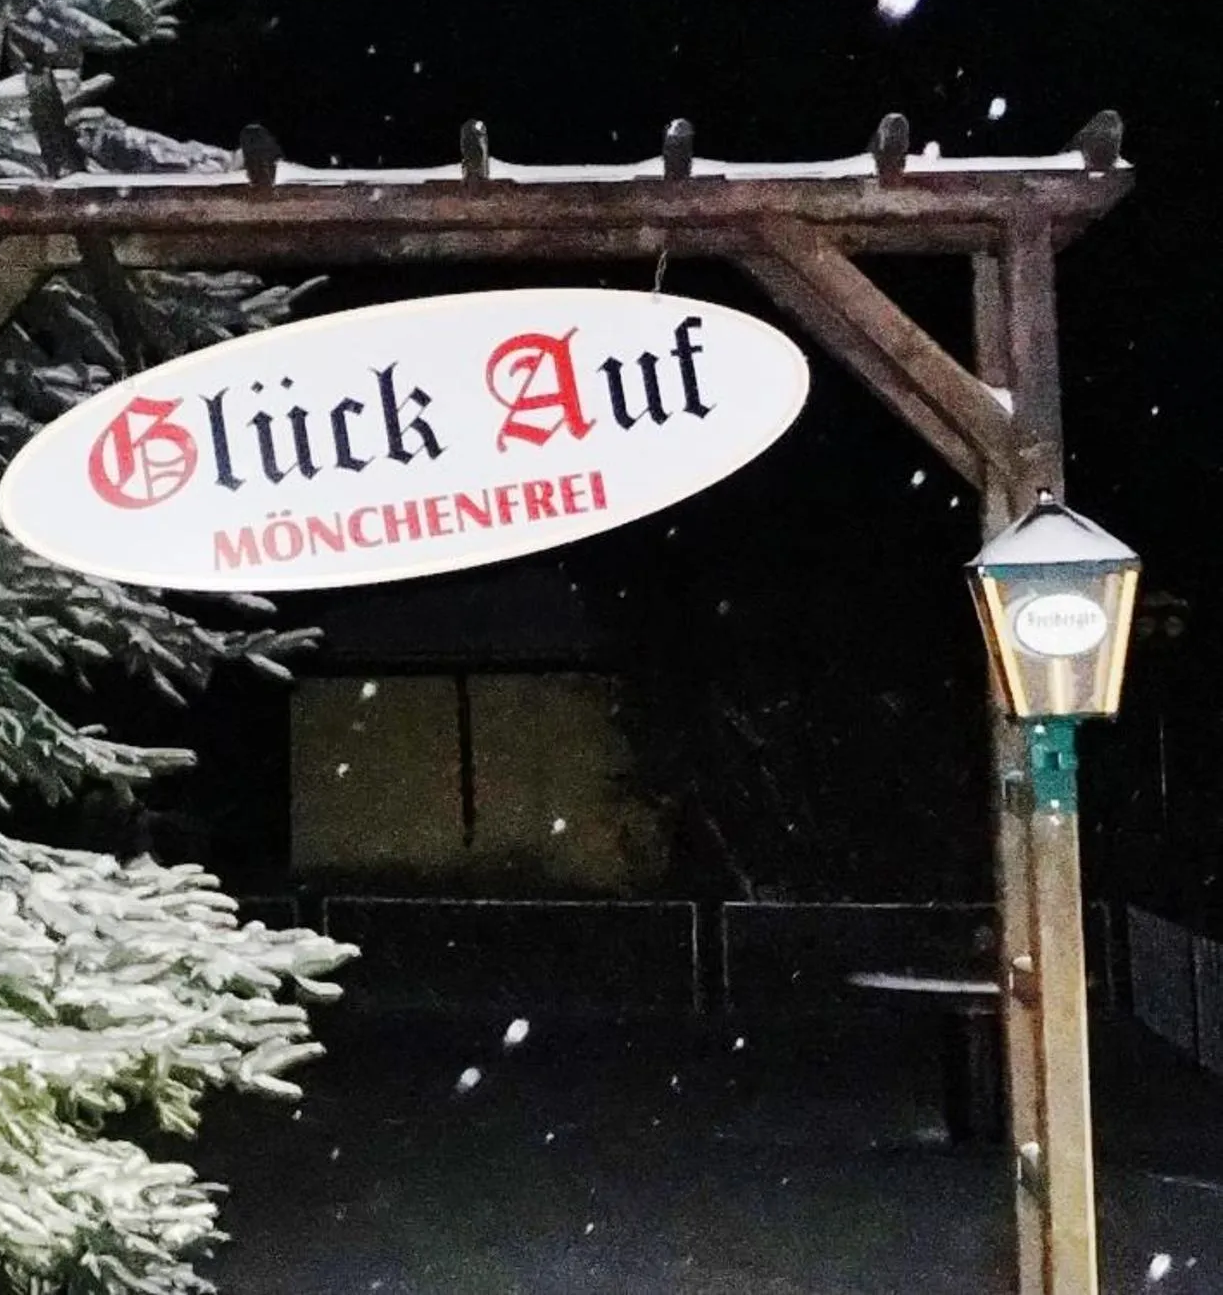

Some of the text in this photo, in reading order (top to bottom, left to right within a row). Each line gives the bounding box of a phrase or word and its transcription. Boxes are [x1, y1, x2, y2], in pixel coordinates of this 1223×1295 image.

[88, 316, 717, 510] Glück Auf
[213, 470, 609, 572] MÖNCHENFREI
